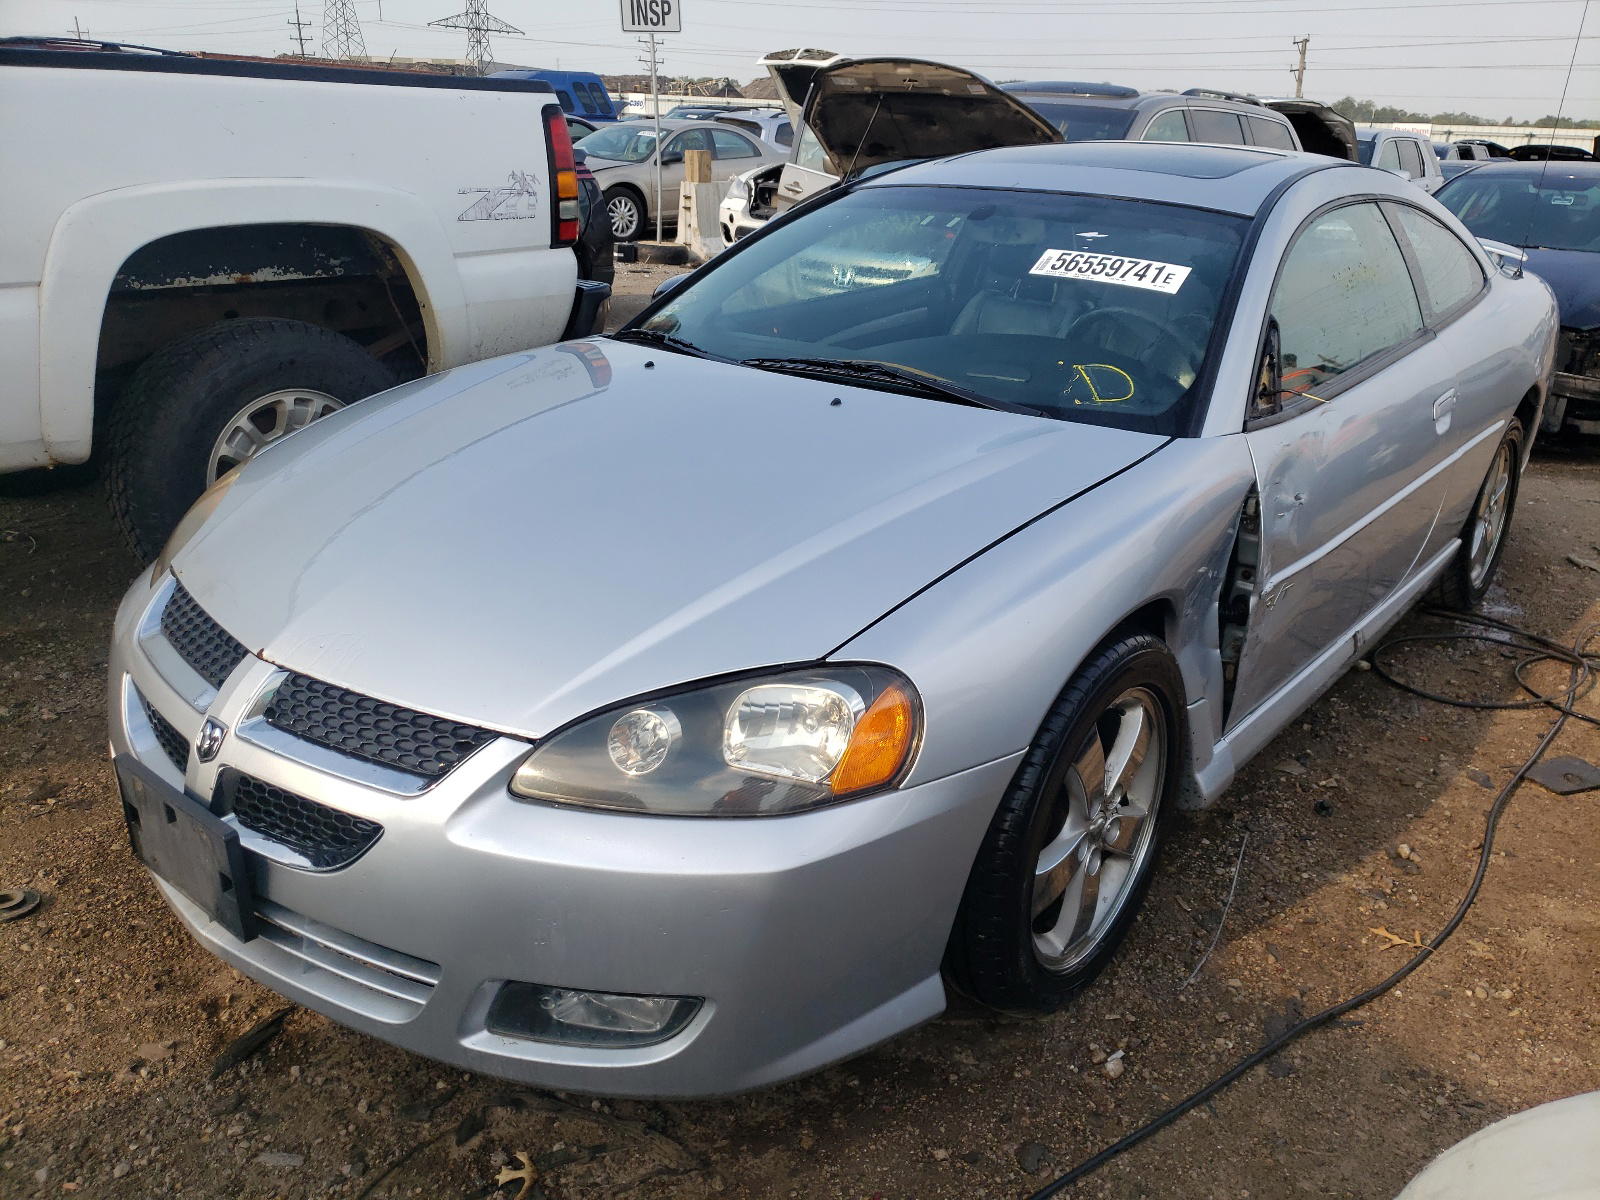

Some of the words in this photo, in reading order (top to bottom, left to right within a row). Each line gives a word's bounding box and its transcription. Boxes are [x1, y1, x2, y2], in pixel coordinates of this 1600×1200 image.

[631, 0, 671, 26] INSP
[1050, 252, 1167, 284] 56559741
[1162, 273, 1176, 285] E
